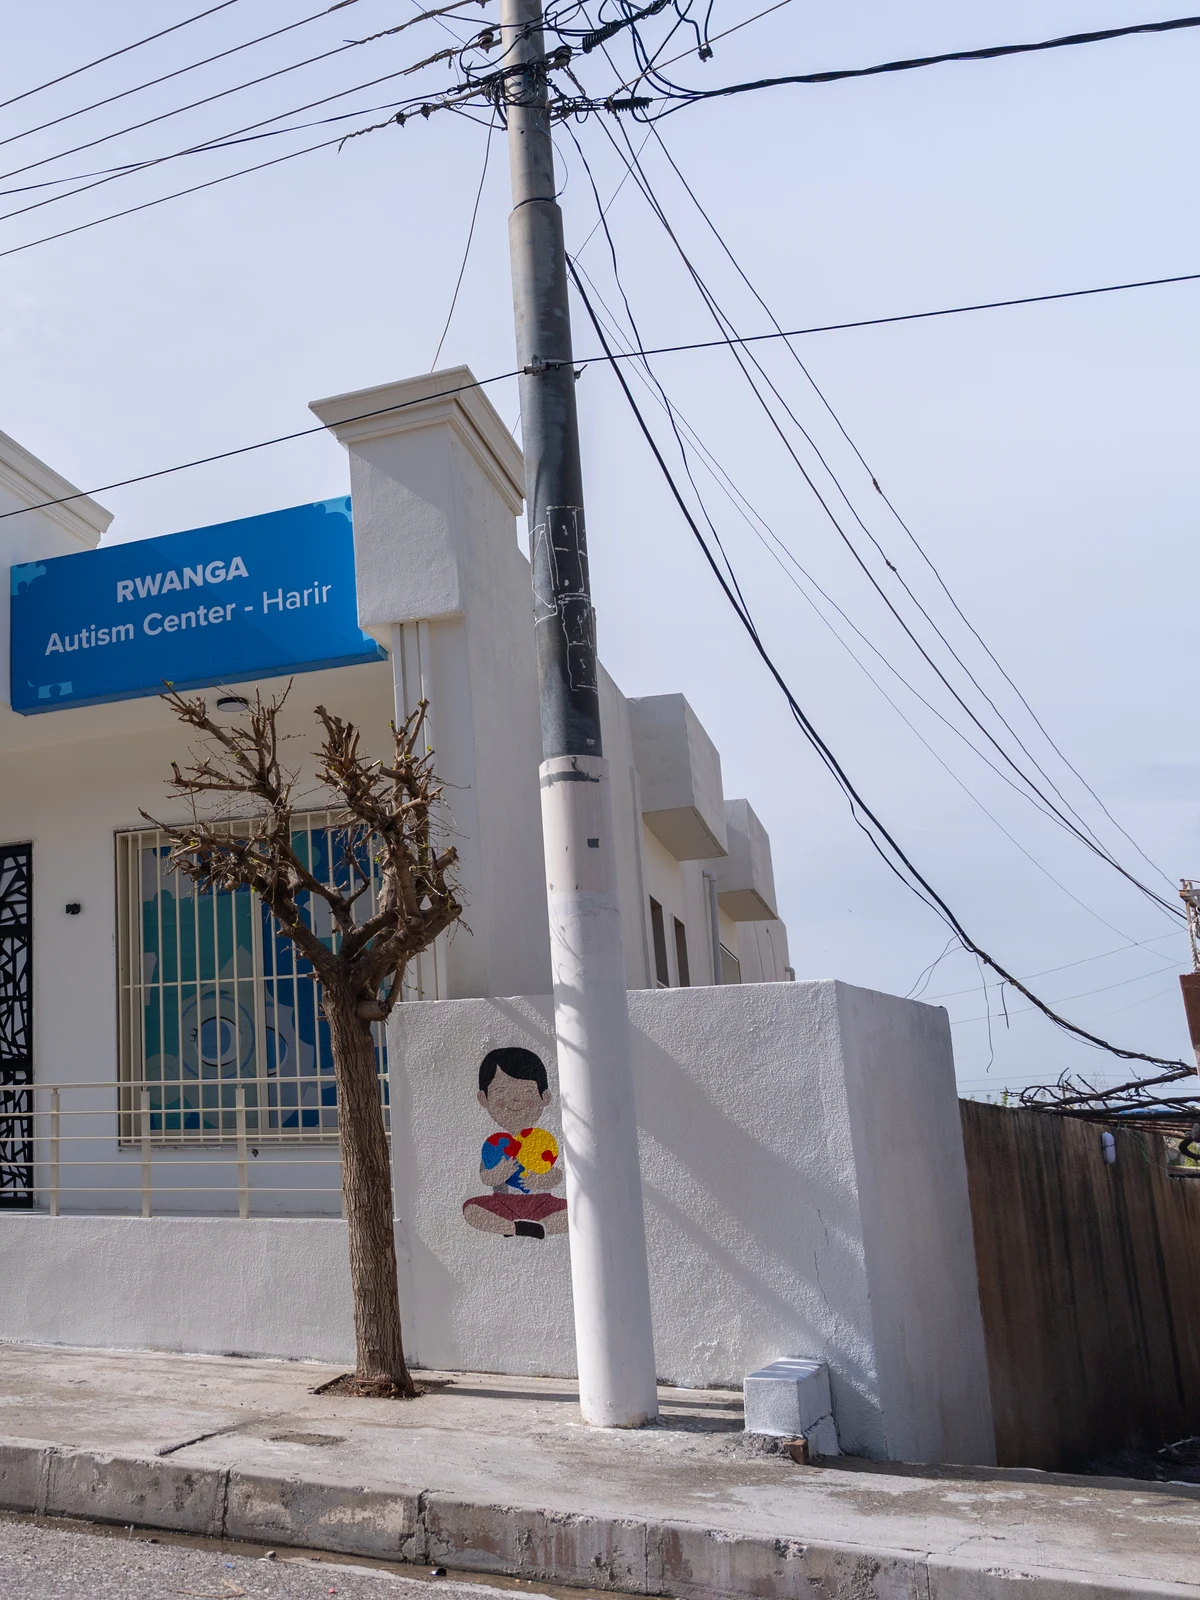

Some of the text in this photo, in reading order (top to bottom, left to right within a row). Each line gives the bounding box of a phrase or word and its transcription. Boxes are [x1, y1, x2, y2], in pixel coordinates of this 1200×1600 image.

[116, 556, 249, 603] RWANGA
[44, 622, 135, 655] Autism
[143, 603, 236, 636] Center
[263, 581, 332, 614] Harir
